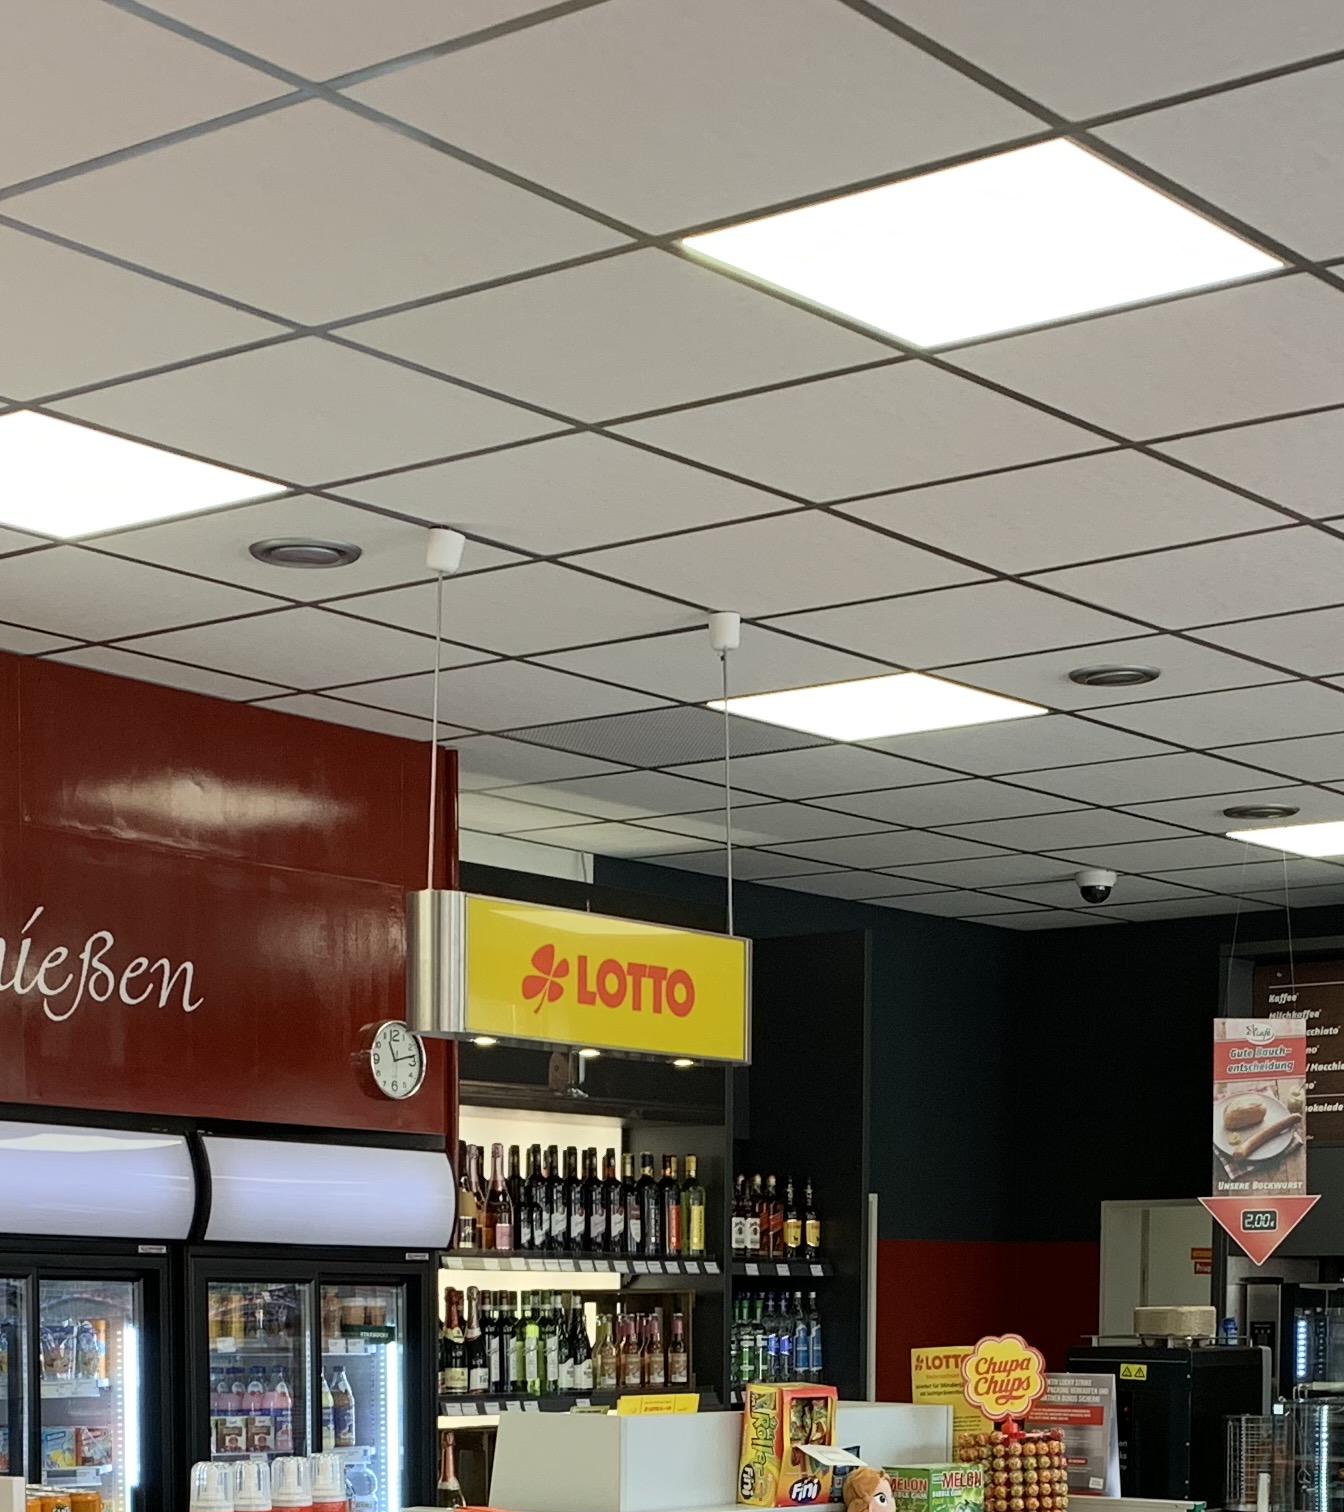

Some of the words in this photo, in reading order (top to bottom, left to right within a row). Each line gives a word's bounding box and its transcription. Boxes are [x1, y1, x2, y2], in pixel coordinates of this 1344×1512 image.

[577, 955, 696, 1018] LOTTO
[389, 1029, 400, 1042] 12
[1230, 1048, 1254, 1058] Gute
[1256, 1046, 1292, 1057] Bauch-
[1227, 1061, 1294, 1073] entscheidung
[1218, 1181, 1249, 1190] UNSERE
[1252, 1181, 1303, 1190] BOCKWURST
[974, 1356, 1031, 1377] Chupa
[974, 1375, 1031, 1405] Chups
[791, 1477, 818, 1500] Fini
